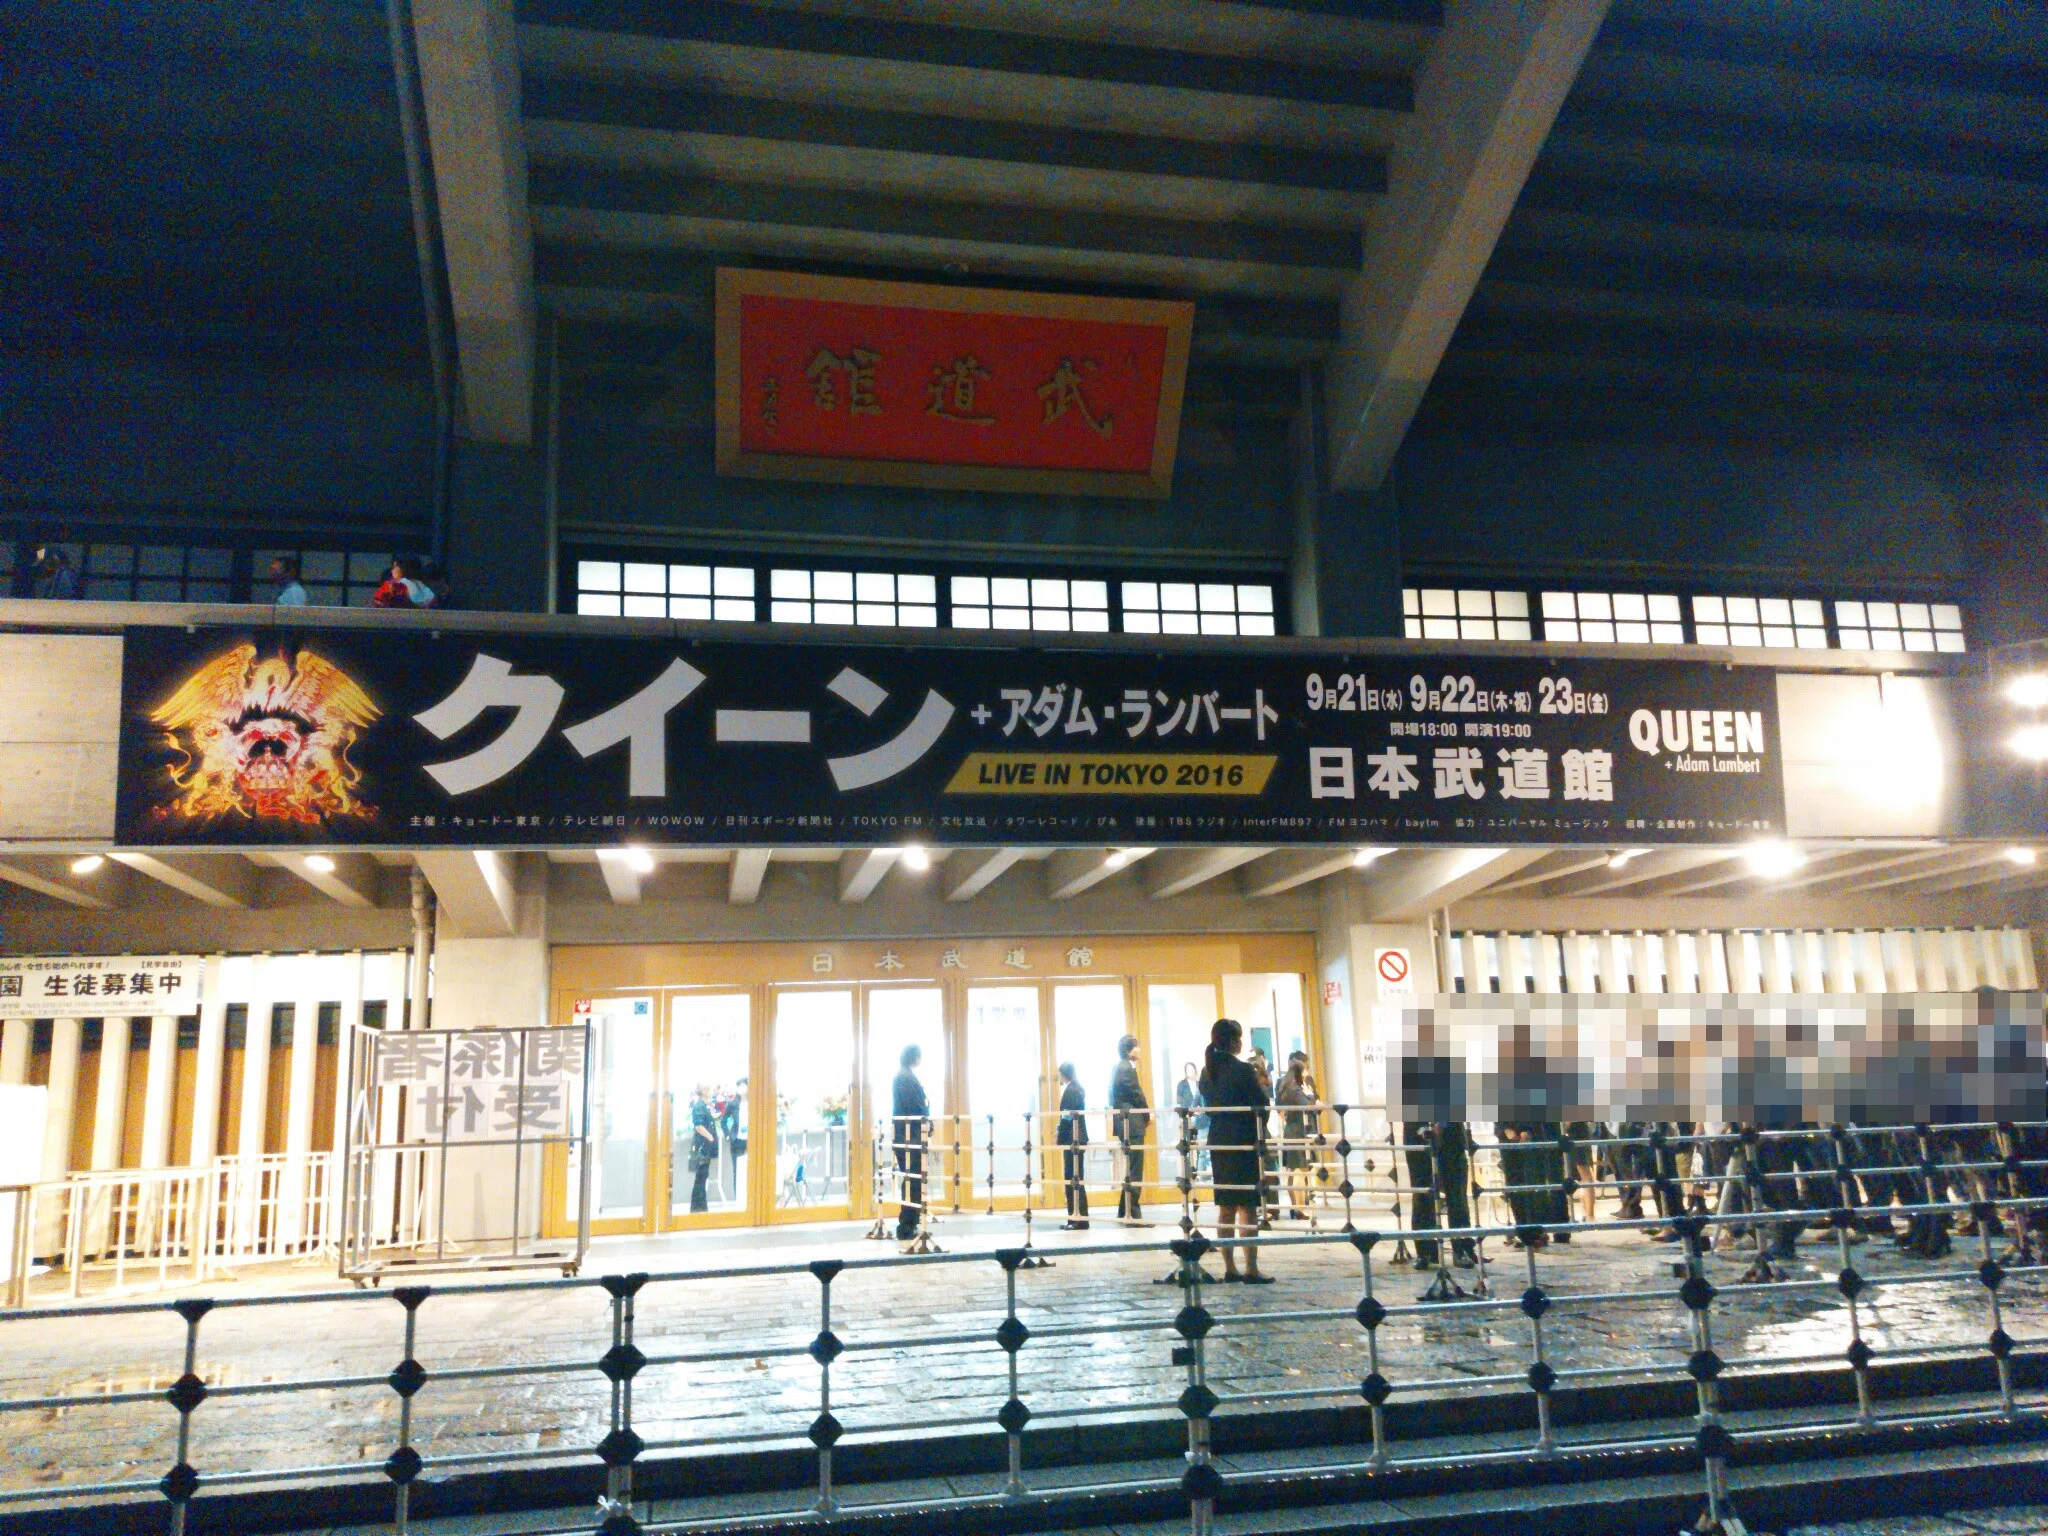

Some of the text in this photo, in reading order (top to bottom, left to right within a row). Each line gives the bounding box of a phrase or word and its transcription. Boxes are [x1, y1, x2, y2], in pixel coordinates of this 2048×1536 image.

[1000, 682, 1279, 741] アダム・ランバート
[411, 652, 957, 797] クイーン
[1629, 709, 1764, 757] QUEEN
[979, 764, 1243, 786] LIVE IN TOKYO 2016
[1309, 746, 1614, 801] 日本武道館
[1676, 757, 1710, 773] Adam
[1713, 757, 1760, 774] Lambert
[565, 815, 625, 826] テレビ朝日
[648, 816, 705, 826] WOWOW
[853, 816, 899, 826] TOKYO
[904, 817, 922, 826] FM
[1006, 816, 1077, 827] タワーレコード
[1405, 818, 1439, 830] bayfm
[811, 947, 1093, 972] 日本武道館
[44, 972, 182, 996] 生徒募集中
